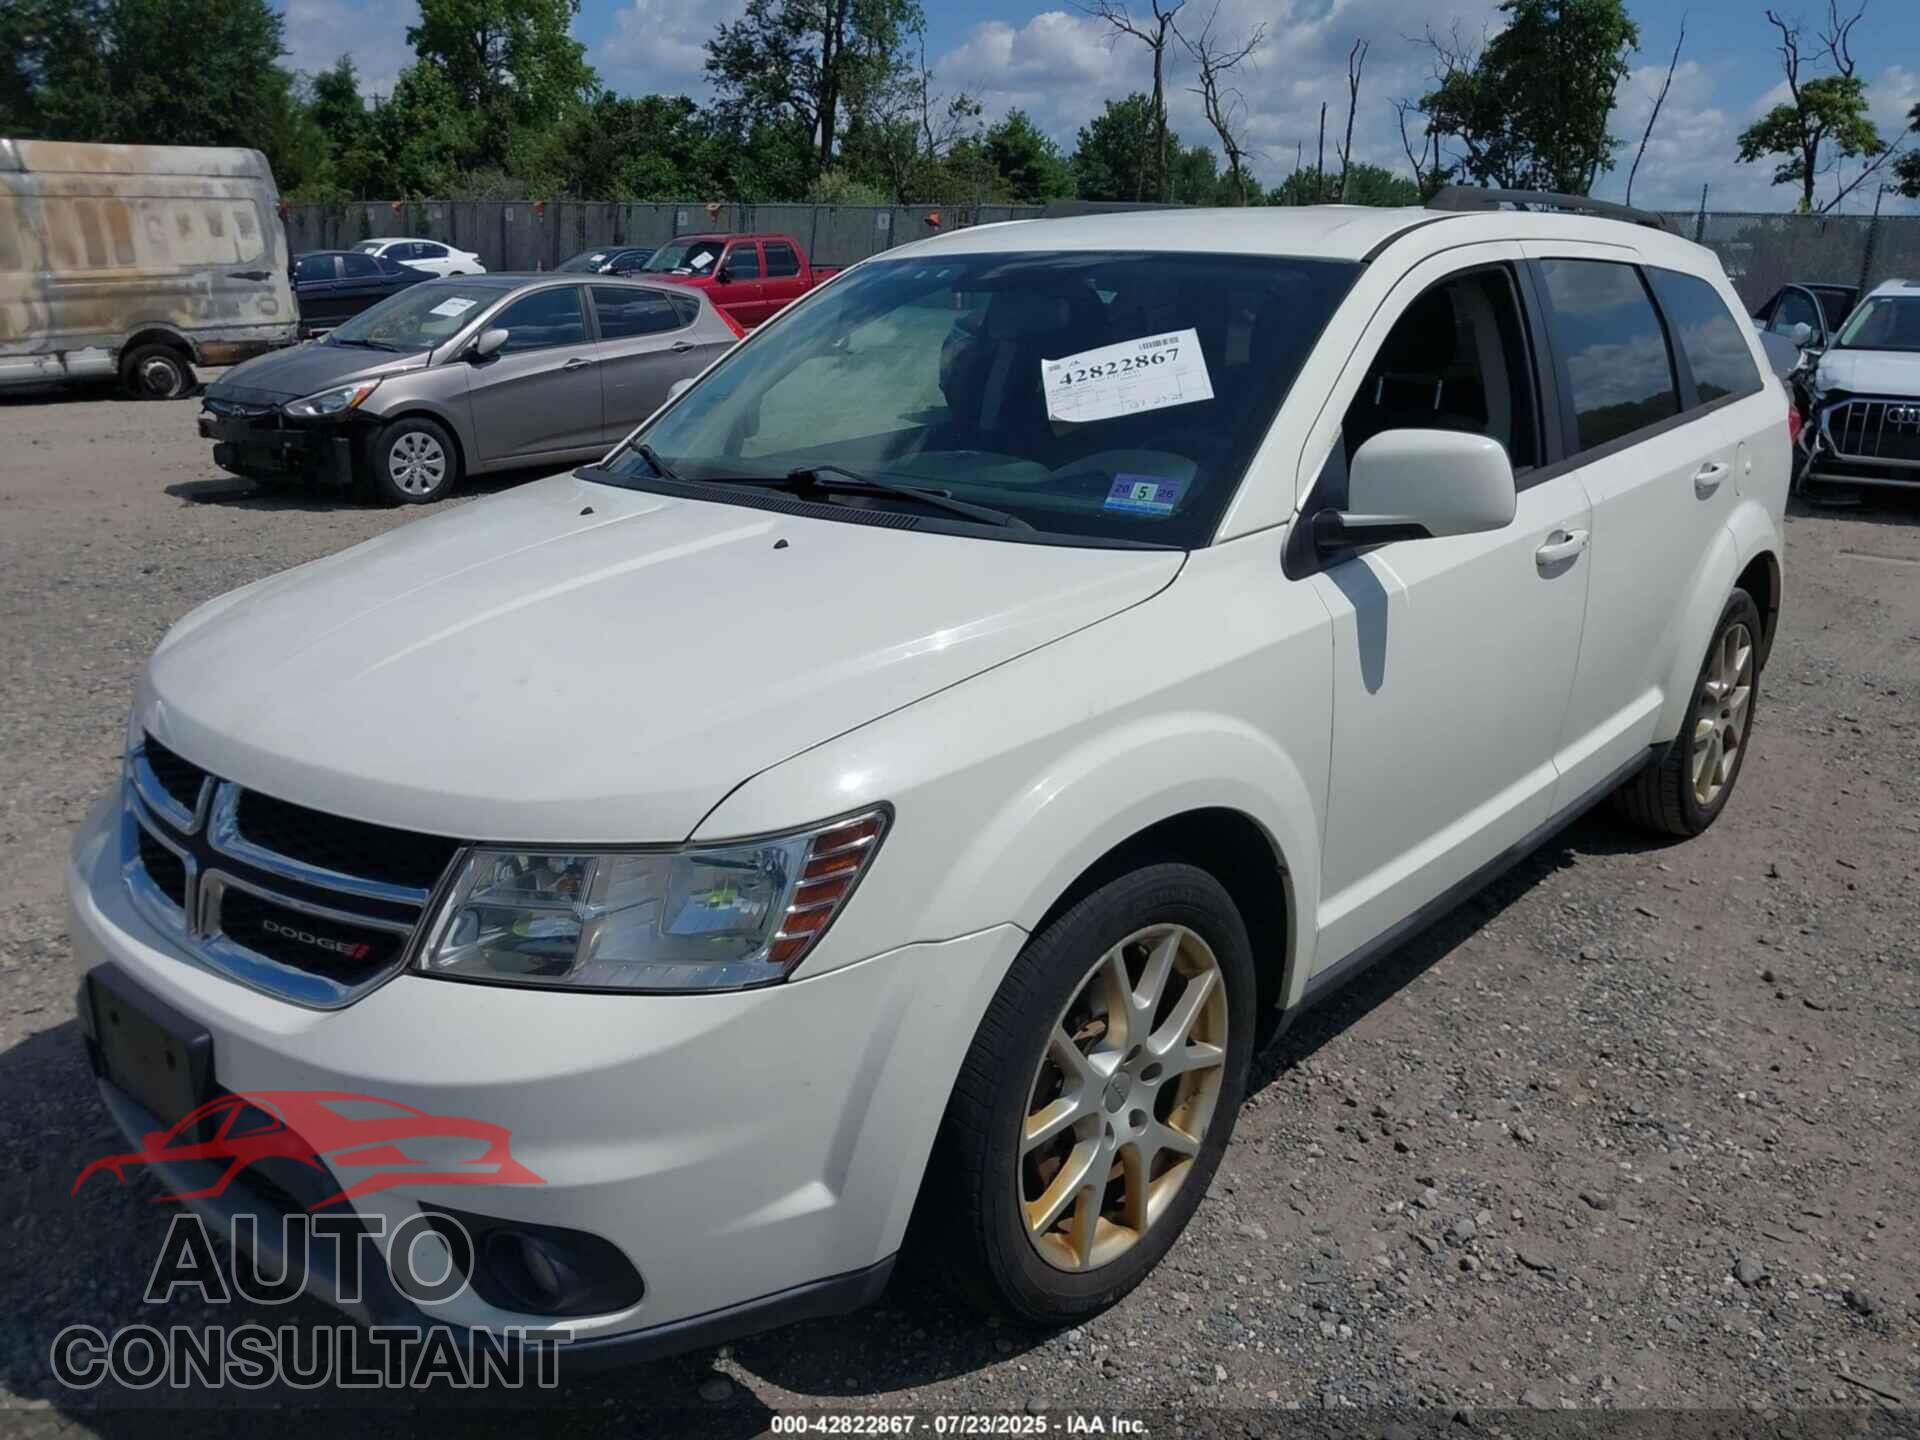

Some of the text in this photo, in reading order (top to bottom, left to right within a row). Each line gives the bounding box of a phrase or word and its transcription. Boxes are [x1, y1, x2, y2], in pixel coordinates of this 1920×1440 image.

[1059, 348, 1180, 385] 42822867
[1138, 485, 1149, 499] 5
[263, 919, 354, 956] DODGE
